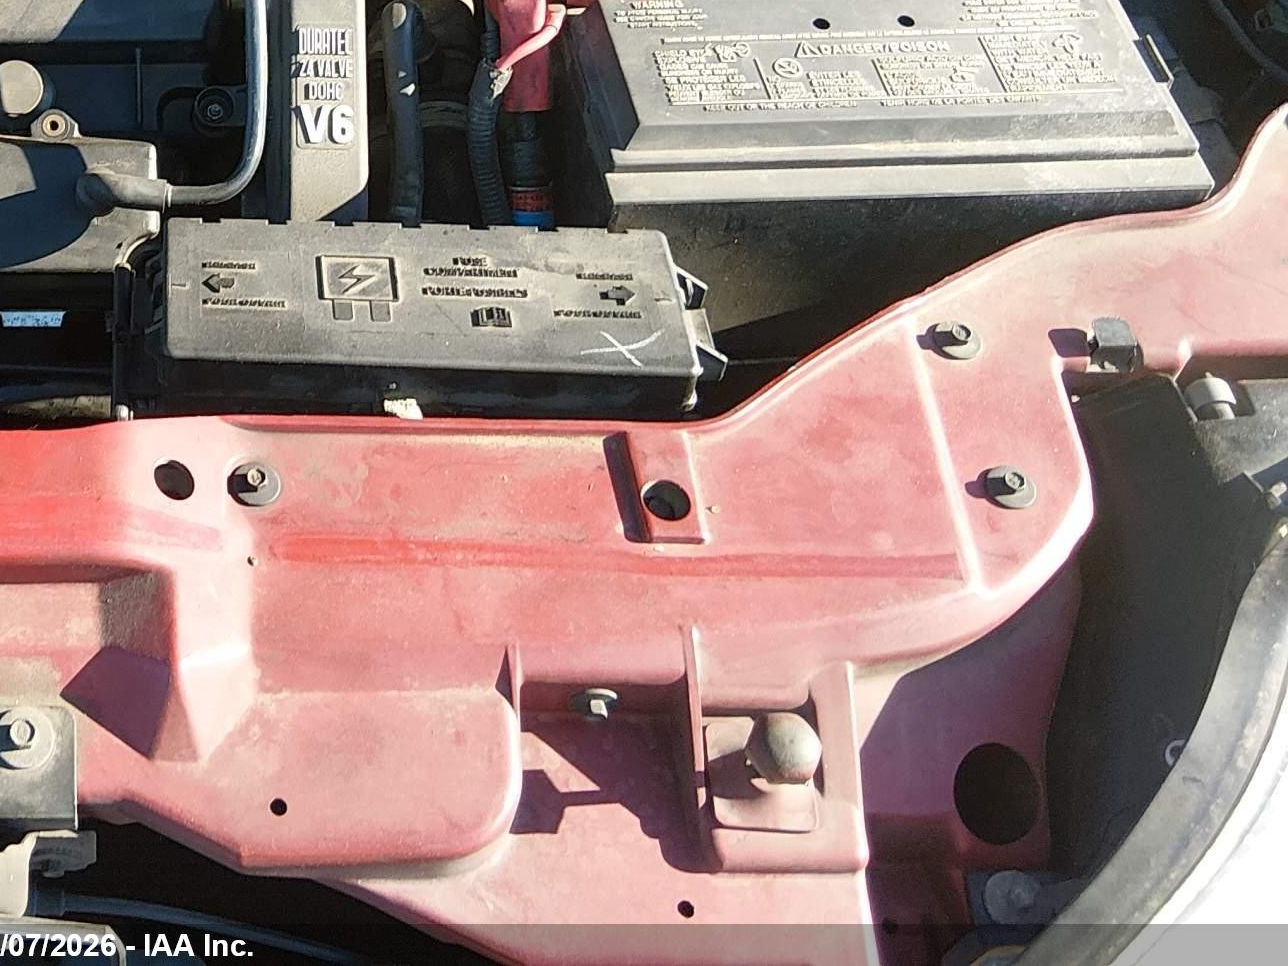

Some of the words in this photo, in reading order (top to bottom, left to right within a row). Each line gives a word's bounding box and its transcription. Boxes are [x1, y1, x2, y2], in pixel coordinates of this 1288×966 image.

[632, 0, 684, 10] WARNING
[299, 28, 354, 55] DURATEC
[819, 41, 951, 55] DANGER/POISON
[316, 59, 354, 78] VALVE
[308, 81, 345, 101] DOHC
[299, 105, 355, 145] V6
